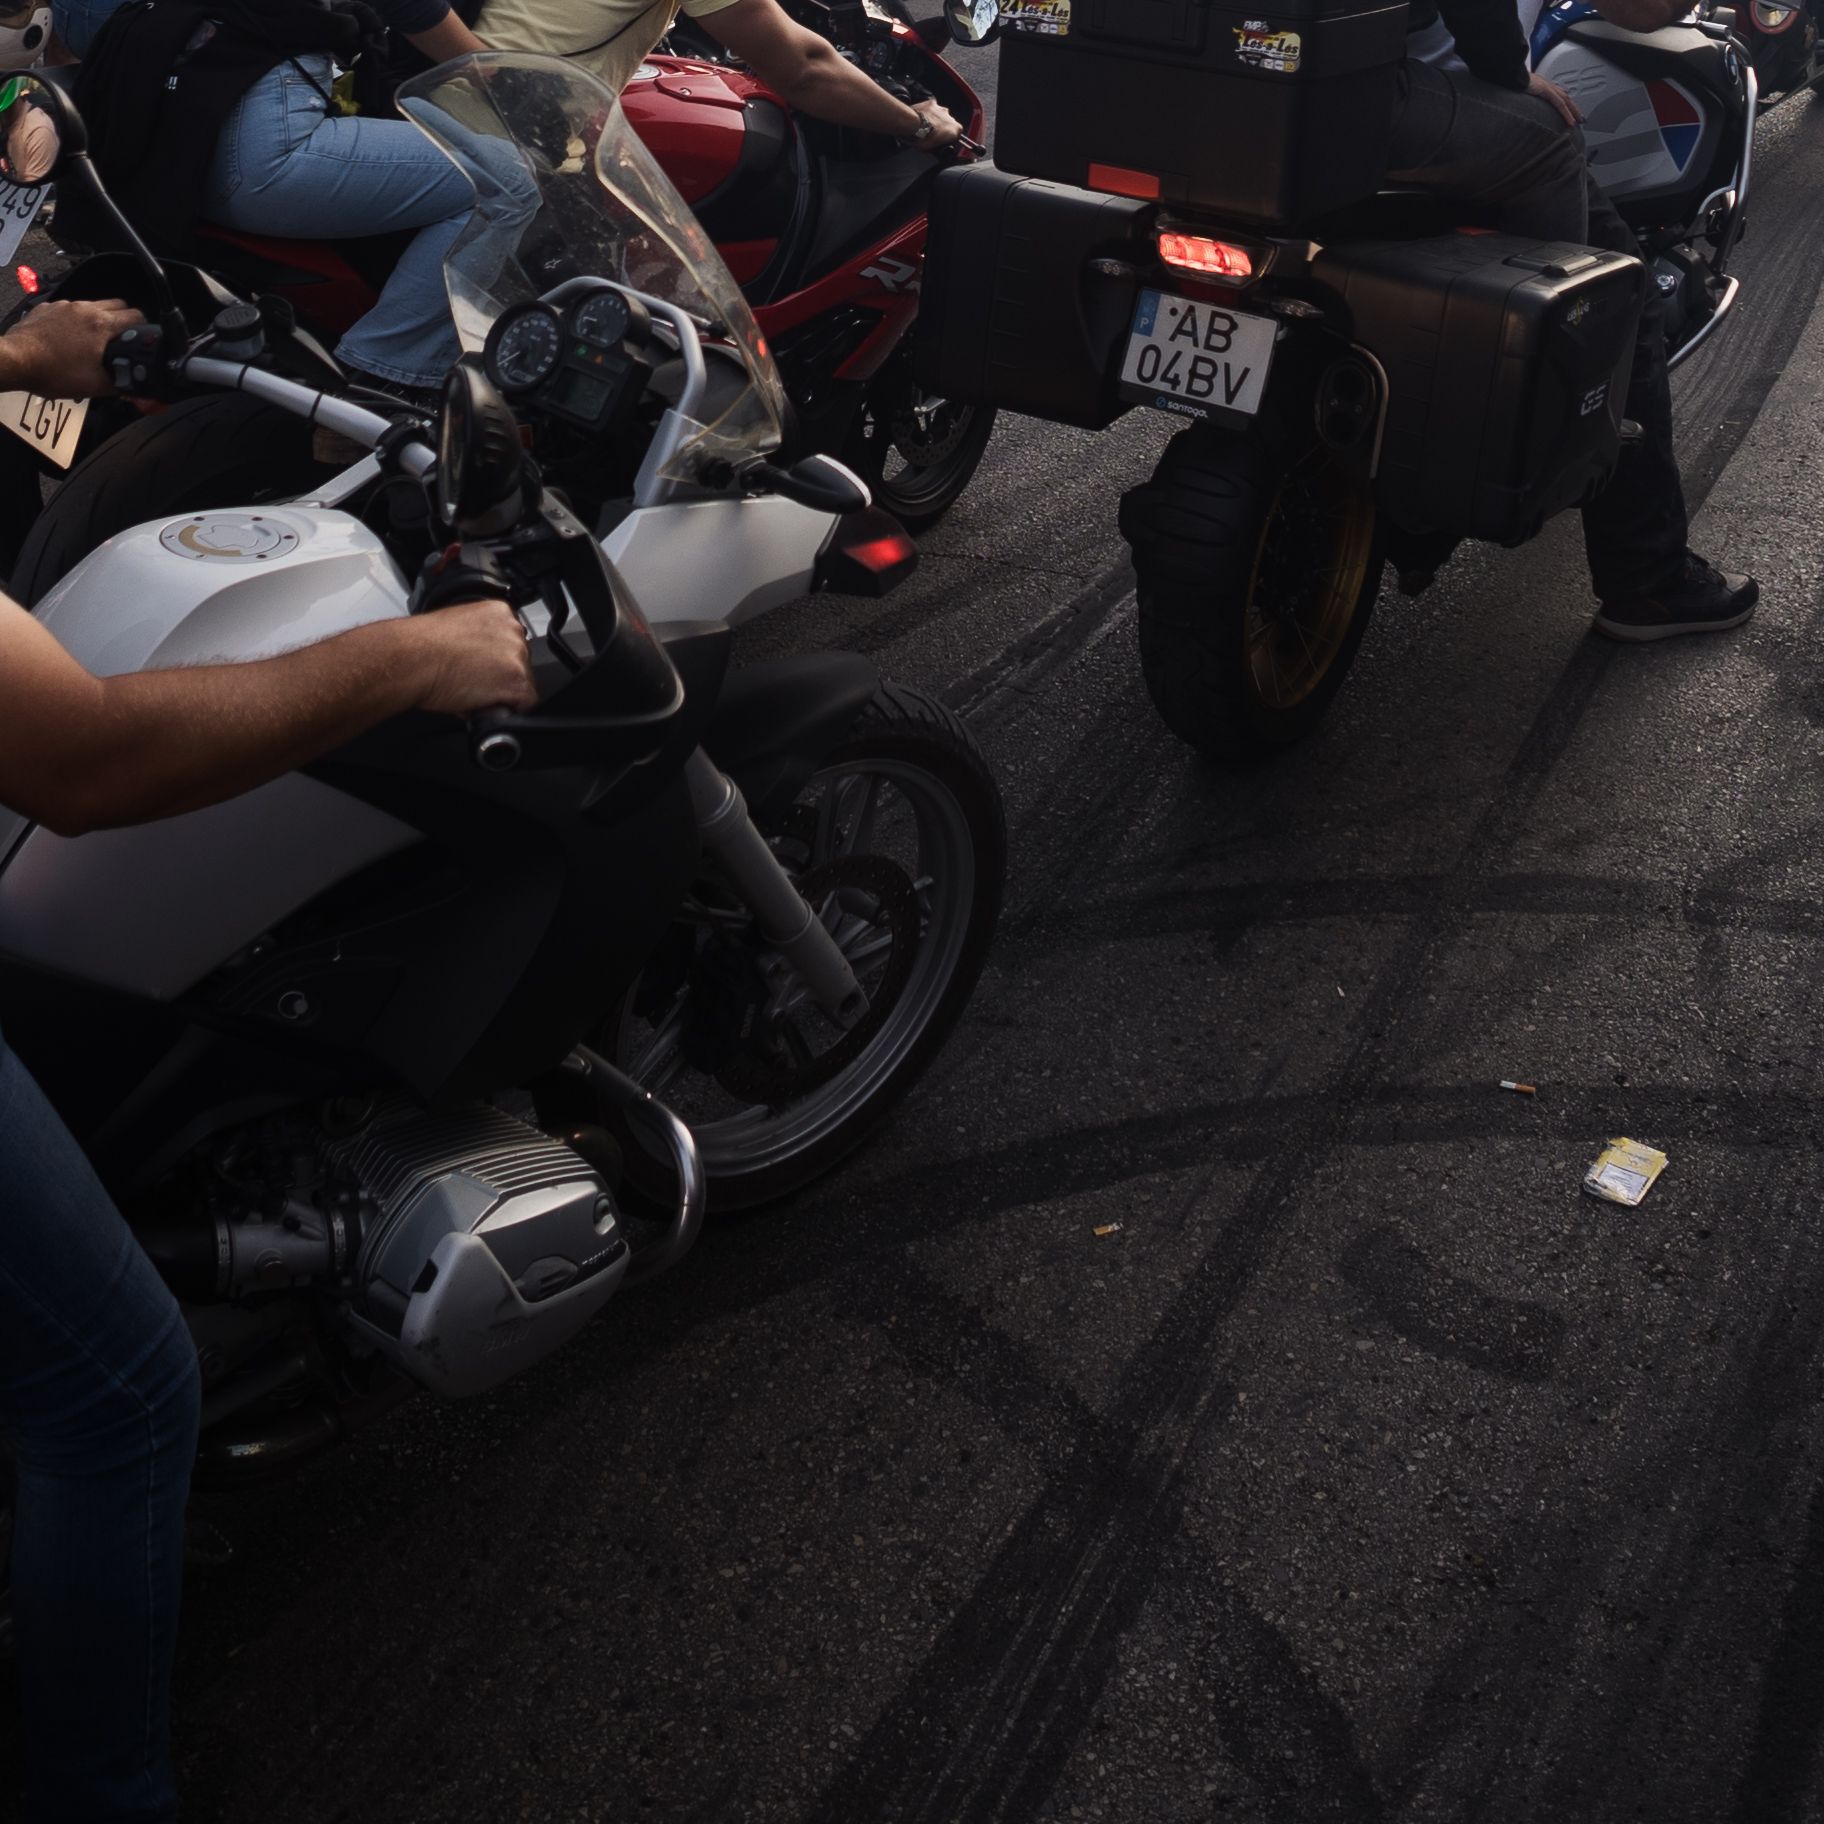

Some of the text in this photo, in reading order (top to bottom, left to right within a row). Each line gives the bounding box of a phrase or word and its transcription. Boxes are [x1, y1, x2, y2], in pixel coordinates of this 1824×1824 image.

[1139, 316, 1151, 331] P
[1168, 304, 1239, 354] AB
[1136, 344, 1251, 406] 04BV
